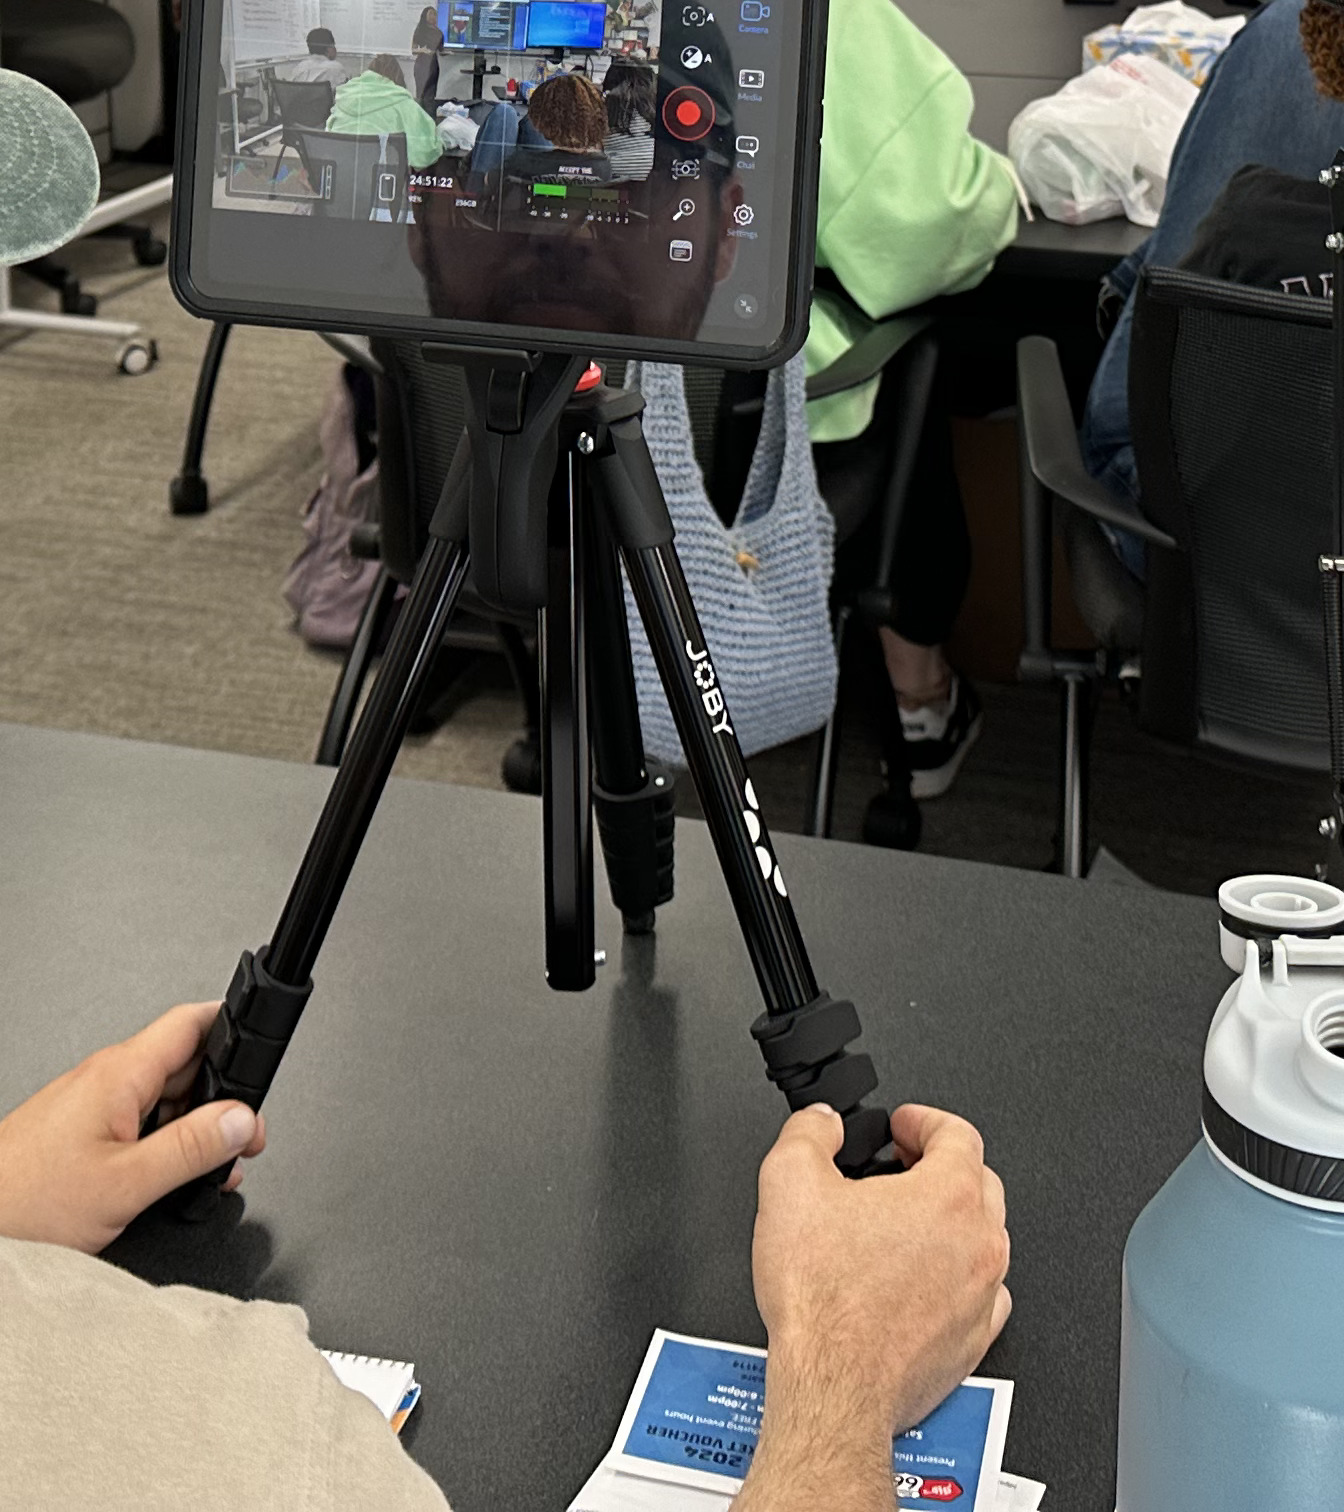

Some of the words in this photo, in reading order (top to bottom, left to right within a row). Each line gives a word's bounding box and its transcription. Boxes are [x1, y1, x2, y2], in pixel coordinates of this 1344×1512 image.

[706, 13, 715, 23] A
[739, 24, 769, 34] Camera
[704, 54, 713, 64] A
[737, 92, 763, 102] Media
[736, 161, 756, 170] Chat
[409, 175, 453, 188] 24:51:22
[726, 228, 758, 240] Settings
[685, 640, 734, 736] JOBY
[664, 1408, 695, 1423] hours
[695, 1415, 726, 1428] event
[646, 1423, 724, 1450] VOUCHER
[684, 1445, 744, 1468] 2024
[893, 1451, 914, 1463] this
[915, 1454, 956, 1468] Present
